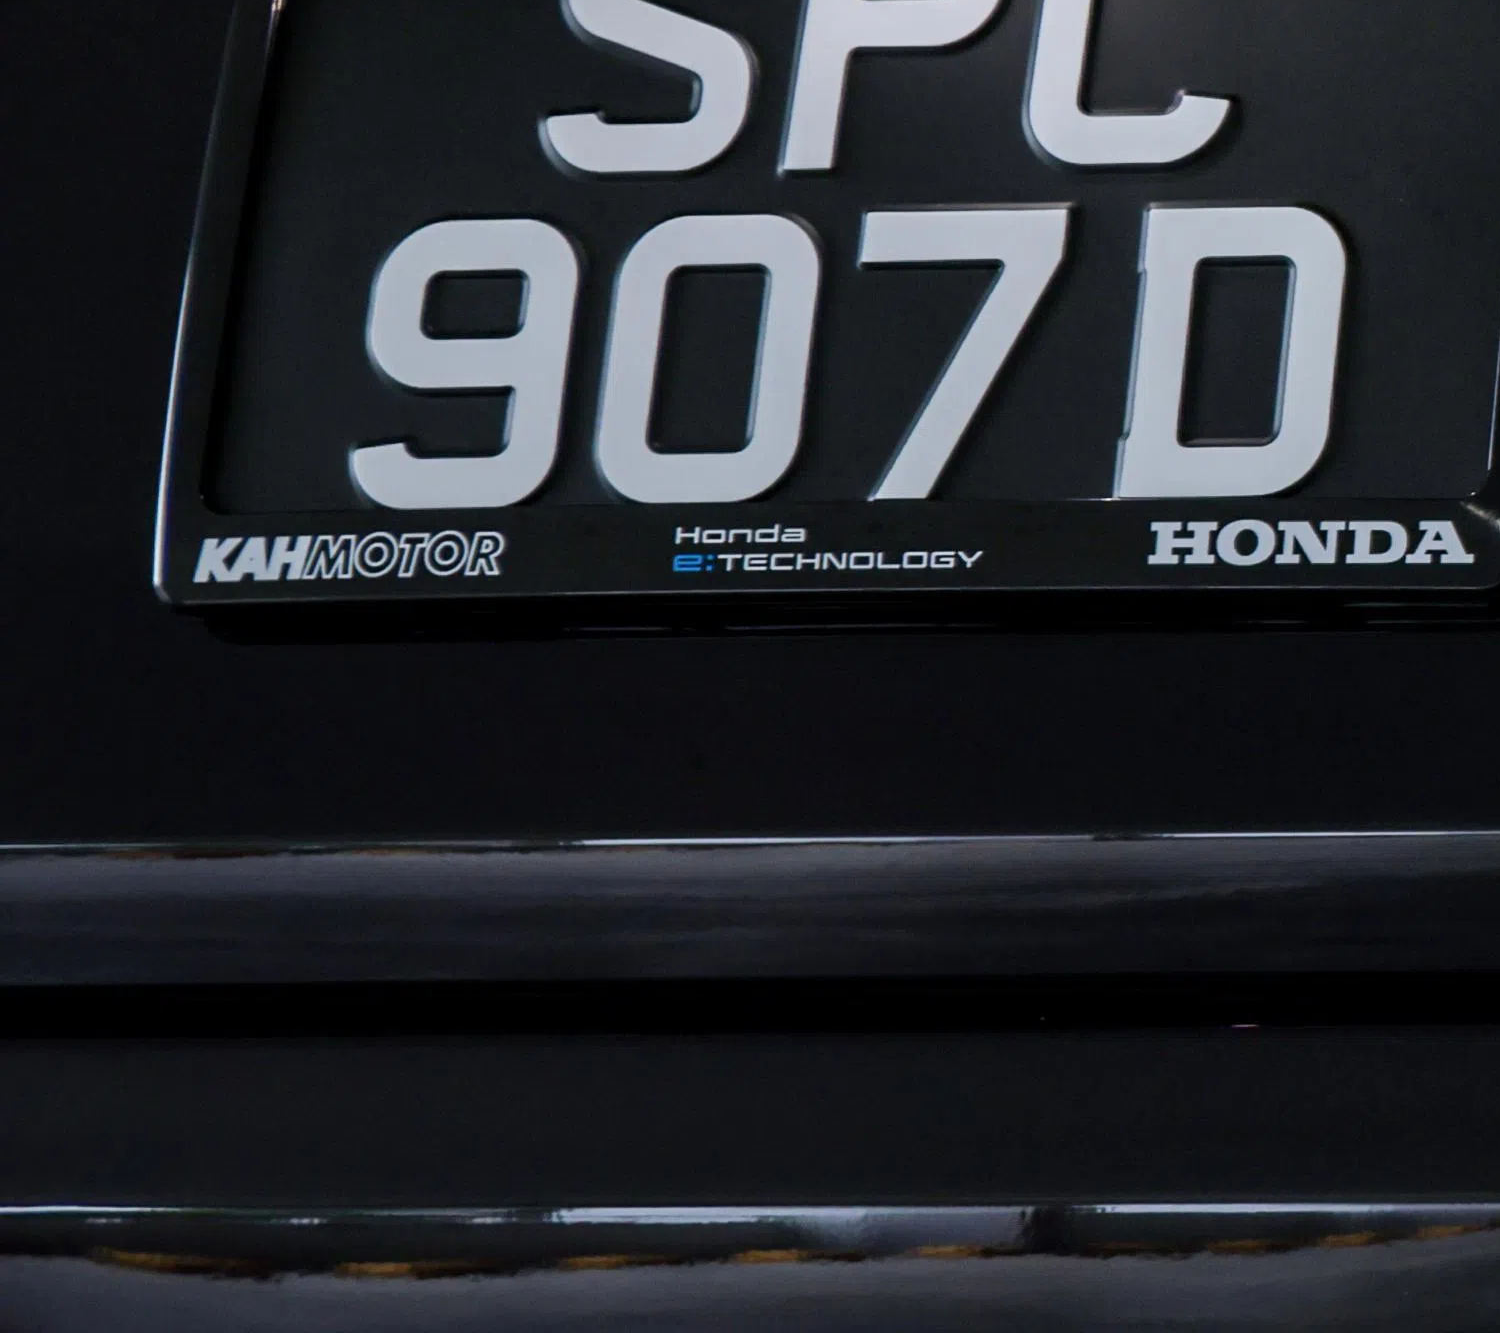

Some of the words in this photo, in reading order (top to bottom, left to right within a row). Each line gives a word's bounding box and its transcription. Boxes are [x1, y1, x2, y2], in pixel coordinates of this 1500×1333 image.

[348, 202, 1071, 510] 907
[1114, 205, 1347, 498] D
[674, 523, 807, 545] Honda
[1147, 519, 1475, 567] HONDA
